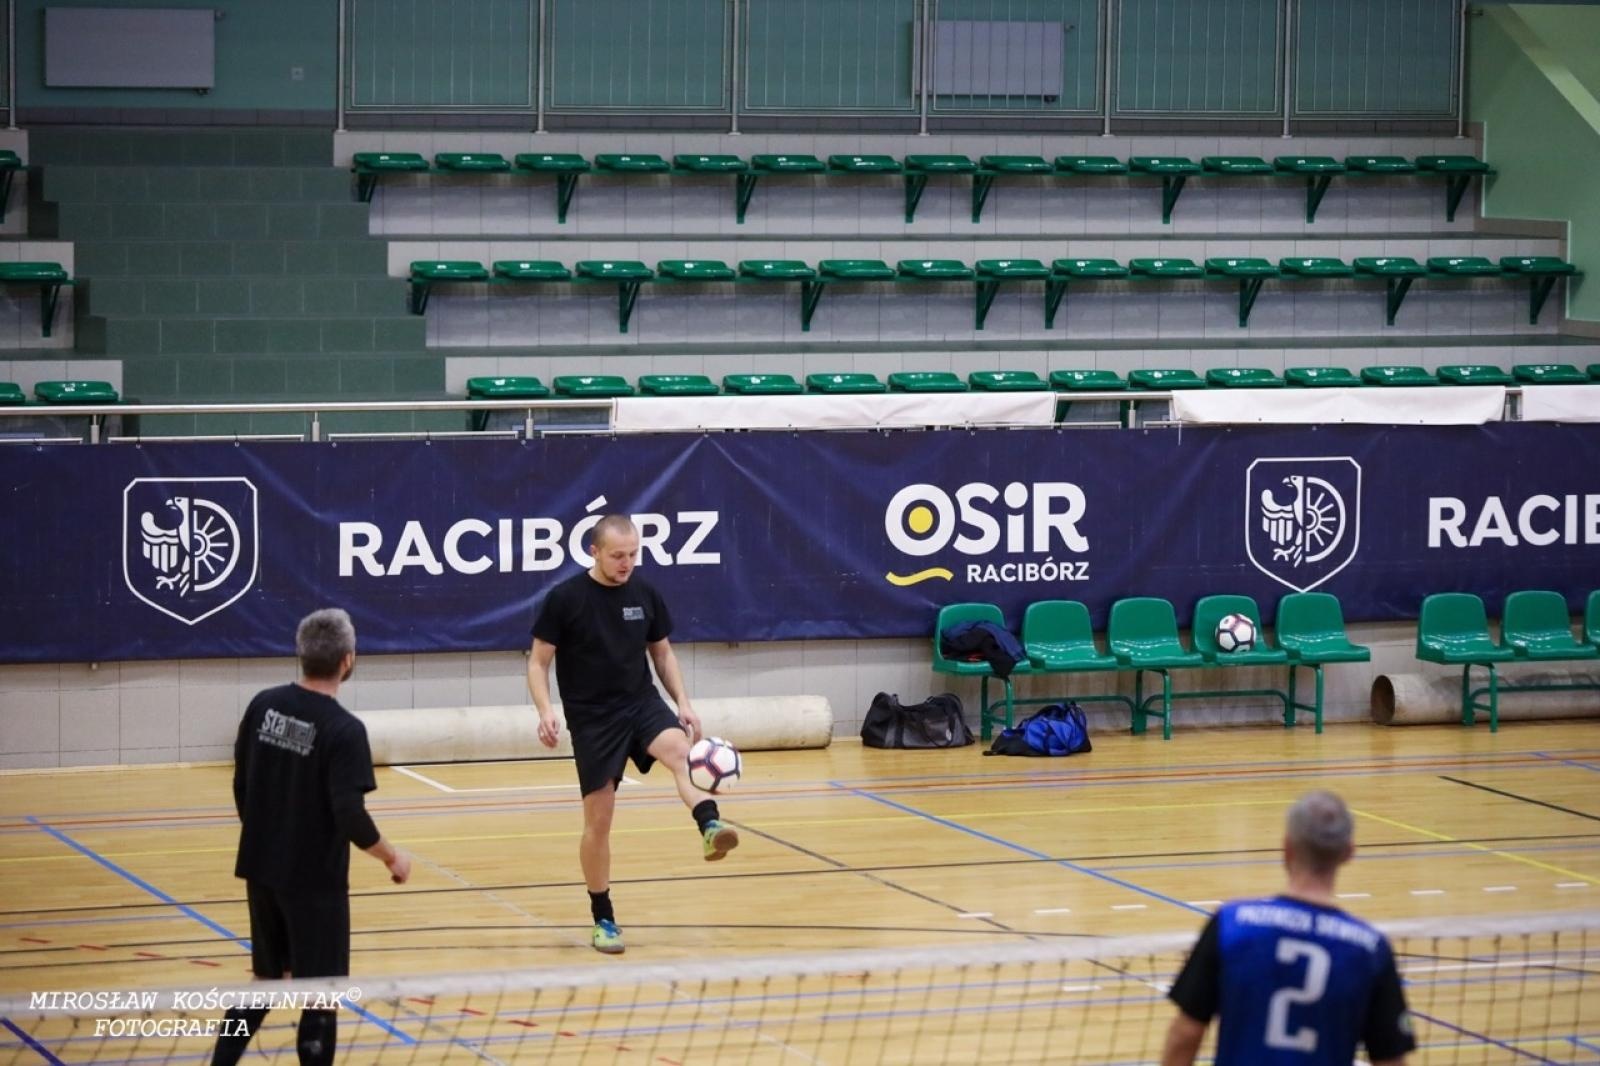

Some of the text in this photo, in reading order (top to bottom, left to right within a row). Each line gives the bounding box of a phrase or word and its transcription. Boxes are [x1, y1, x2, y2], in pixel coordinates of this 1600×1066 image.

[885, 481, 1090, 556] OSiR
[966, 556, 1090, 583] RACIBÓRZ
[1265, 937, 1332, 1053] 2
